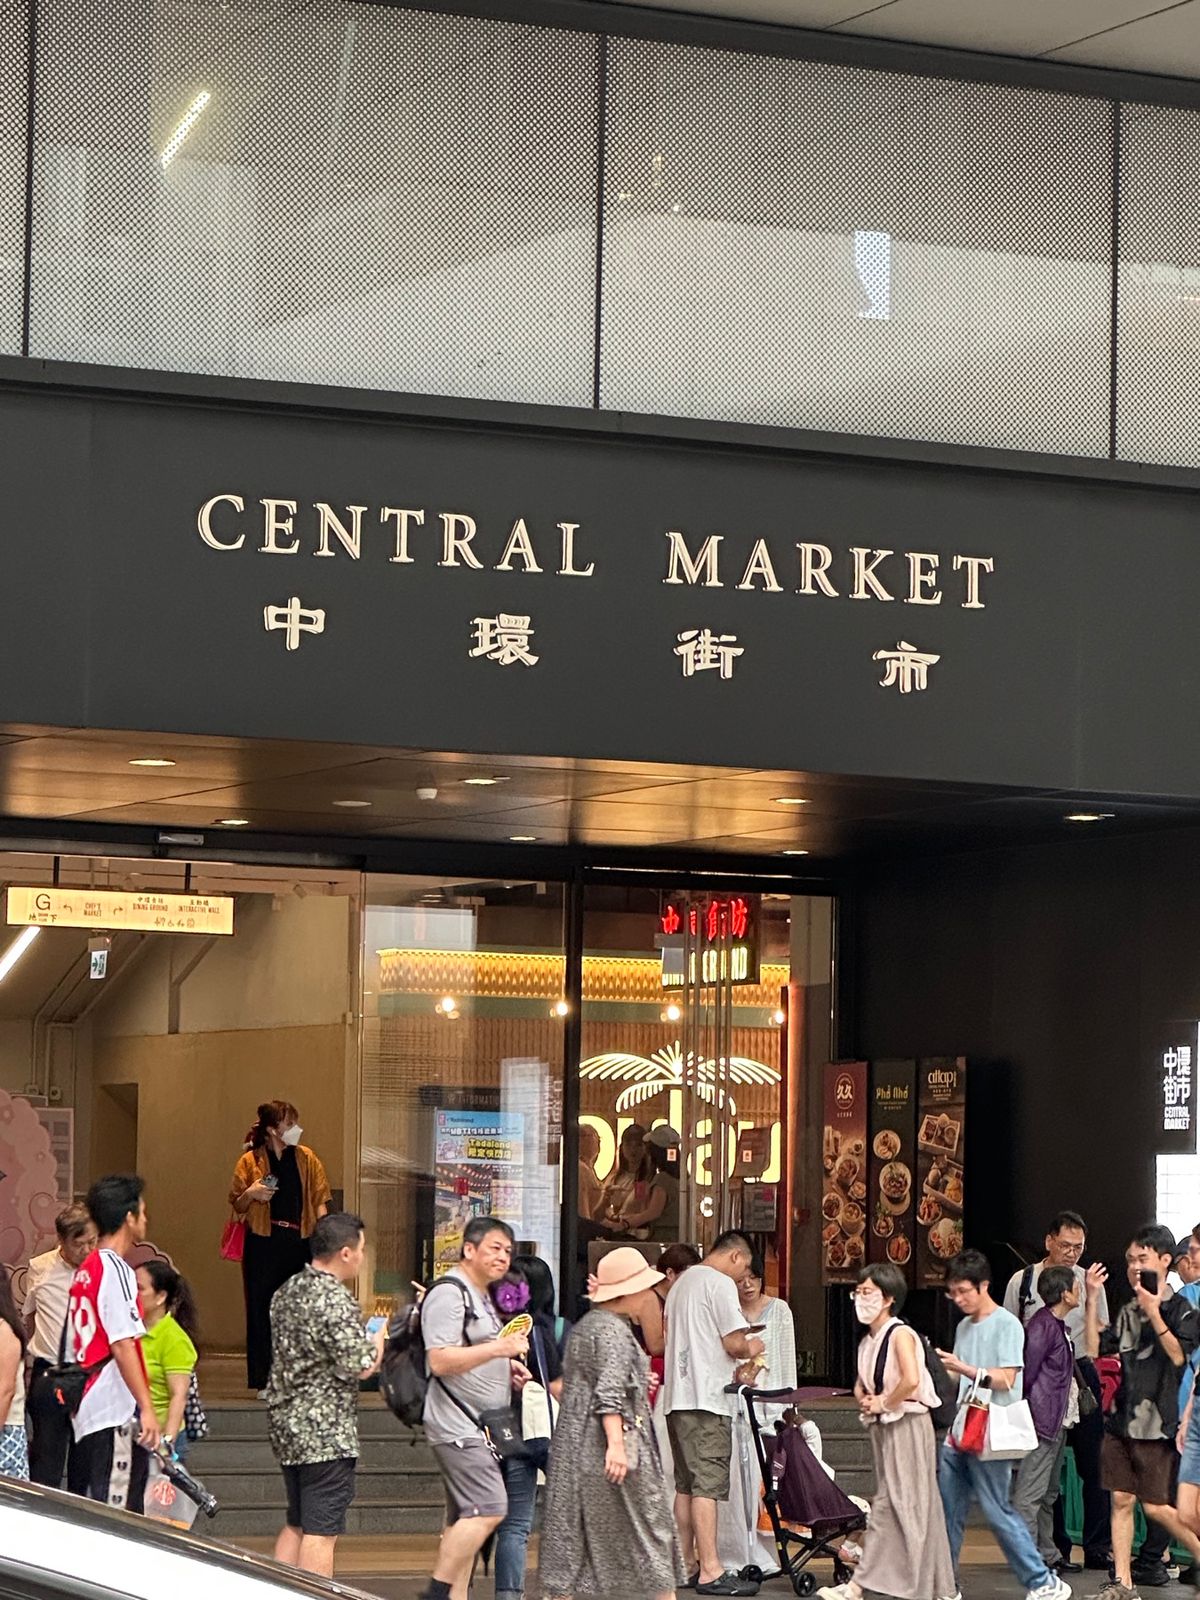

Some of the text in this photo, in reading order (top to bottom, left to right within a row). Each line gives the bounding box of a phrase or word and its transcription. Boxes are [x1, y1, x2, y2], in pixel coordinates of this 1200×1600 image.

[197, 494, 994, 609] CENTRAL MARKET
[36, 893, 51, 911] G
[1164, 1106, 1190, 1118] CENTRAL
